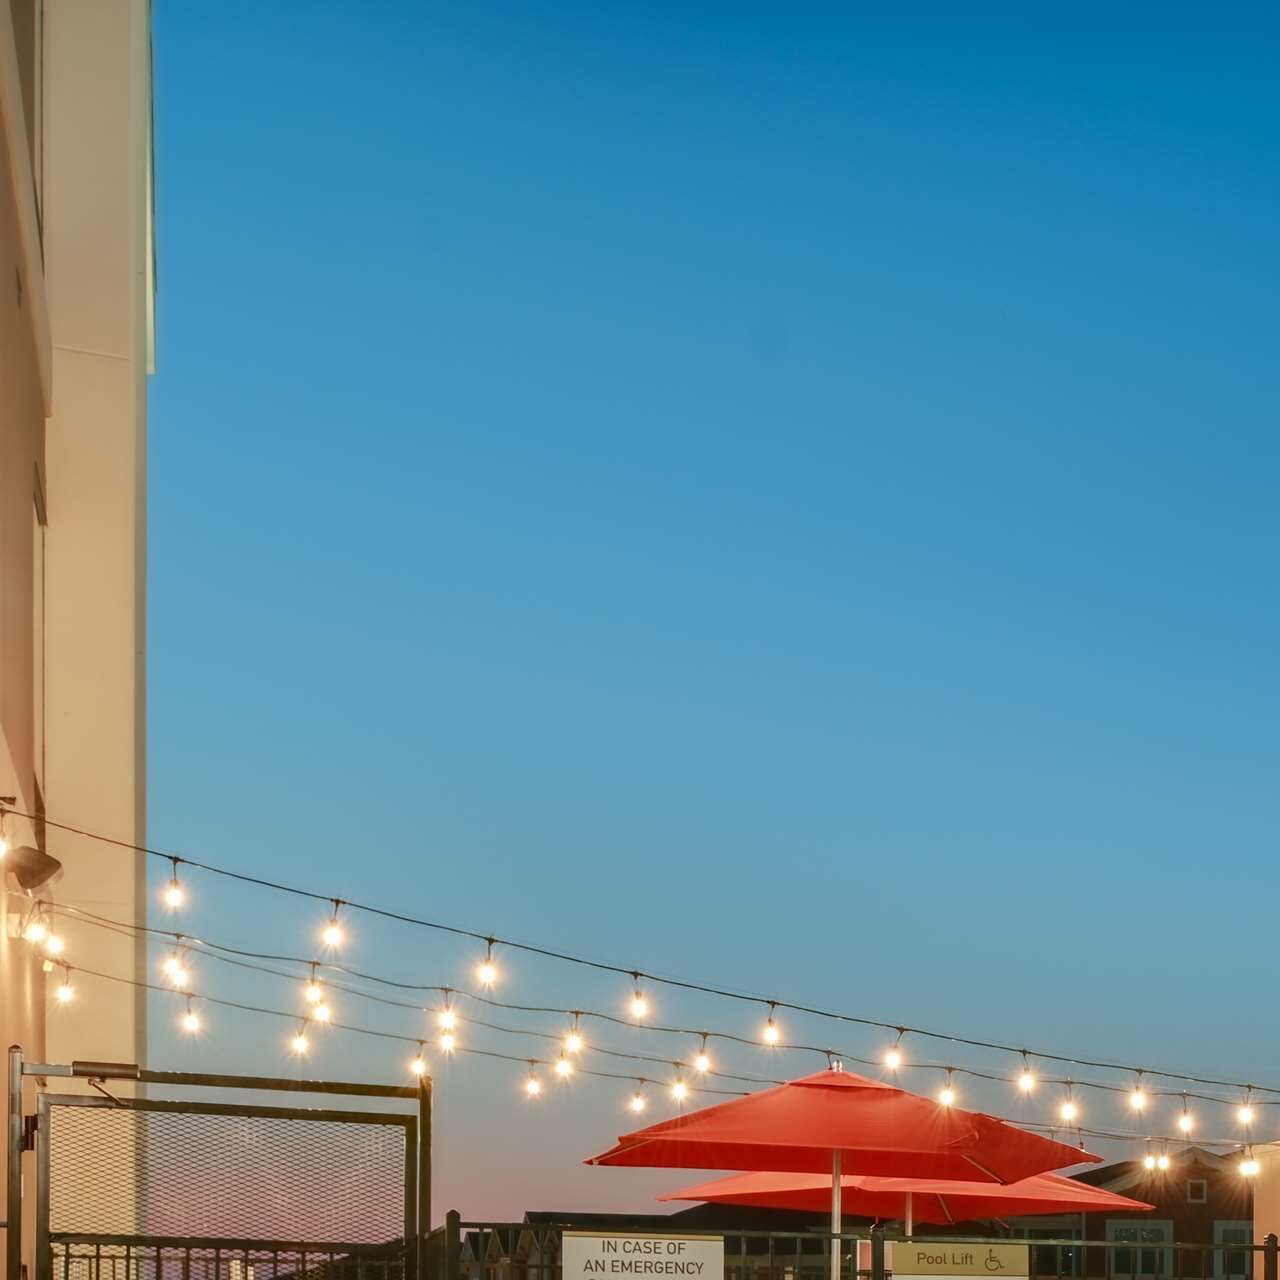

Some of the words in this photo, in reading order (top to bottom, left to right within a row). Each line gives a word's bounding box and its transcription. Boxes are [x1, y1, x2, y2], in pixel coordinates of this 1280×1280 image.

[602, 1240, 617, 1253] IN
[622, 1241, 662, 1255] CASE
[666, 1242, 687, 1255] OF
[917, 1252, 947, 1265] Pool
[952, 1253, 974, 1266] Lift
[583, 1259, 606, 1273] AN
[611, 1260, 704, 1275] EMERGENCY
